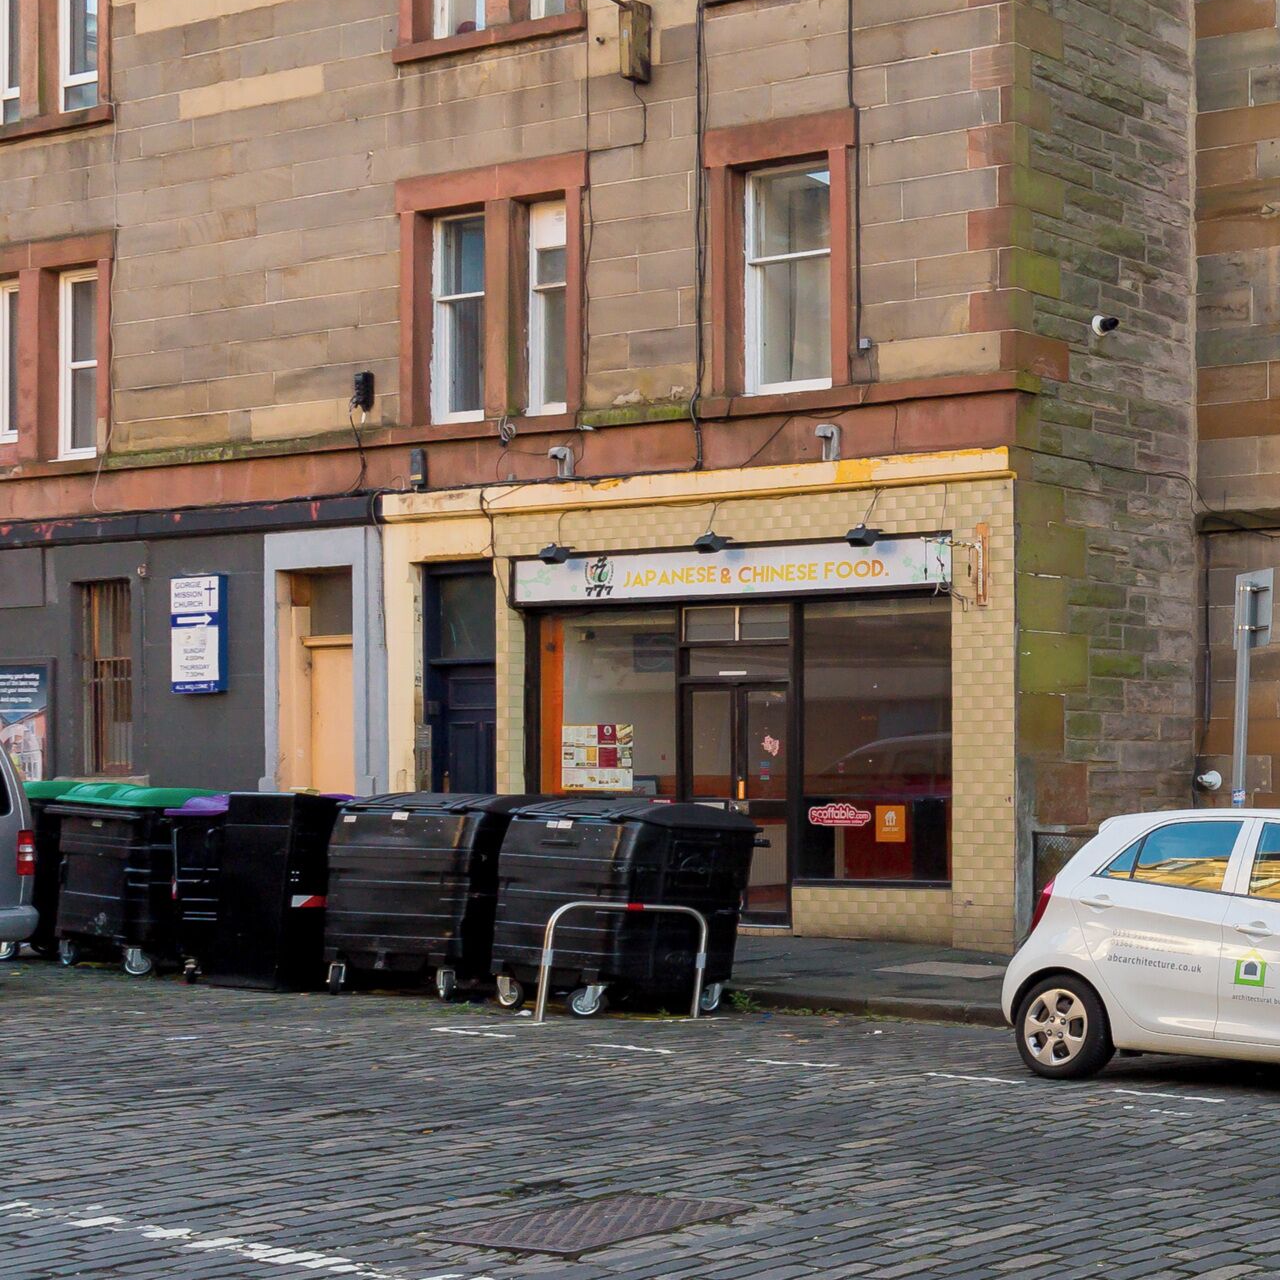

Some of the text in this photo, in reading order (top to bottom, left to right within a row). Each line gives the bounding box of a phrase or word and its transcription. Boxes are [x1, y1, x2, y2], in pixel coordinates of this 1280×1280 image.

[623, 566, 717, 588] JAPANESE
[720, 568, 731, 584] &
[738, 563, 819, 584] CHINESE
[174, 591, 203, 599] MISSION
[585, 584, 613, 597] 777
[174, 601, 203, 609] CHURCH
[1107, 953, 1202, 973] abcarchitecture.co.uk
[1232, 994, 1273, 1004] architectural
